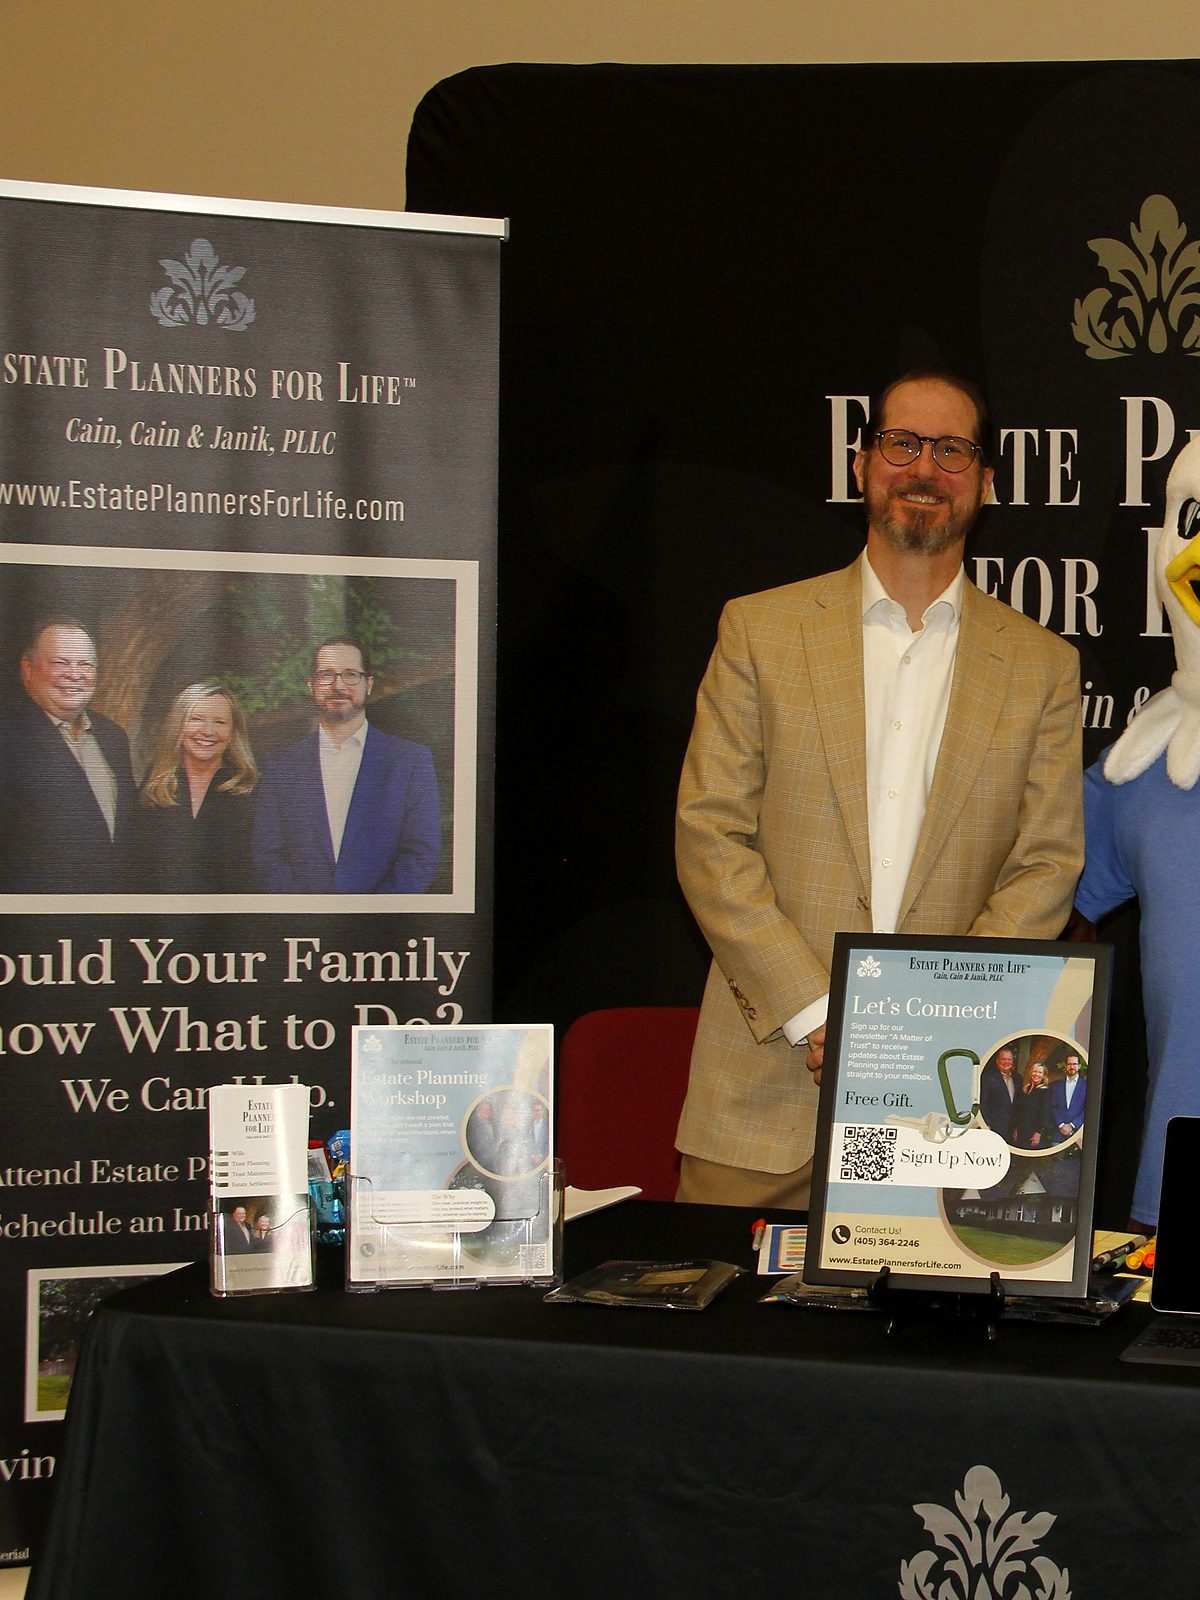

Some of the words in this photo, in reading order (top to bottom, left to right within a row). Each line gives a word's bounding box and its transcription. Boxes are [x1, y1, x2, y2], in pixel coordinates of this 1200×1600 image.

[3, 353, 89, 388] STATE
[103, 347, 256, 398] PLANNERS
[271, 369, 324, 401] FOR
[65, 417, 122, 450] Cain,
[130, 420, 180, 448] Cain
[187, 424, 204, 449] &
[210, 425, 275, 457] Janik,
[282, 429, 337, 455] PLLC
[0, 938, 116, 986] ould
[129, 938, 266, 985] Your
[283, 937, 470, 996] Family
[909, 957, 939, 971] ESTATE
[943, 958, 985, 973] PLANNERS
[988, 963, 1004, 973] FOR
[934, 971, 949, 980] Cain,
[949, 972, 964, 980] Cain
[989, 974, 1004, 982] PLLC
[906, 997, 998, 1020] Connect!
[109, 1006, 267, 1054] What
[285, 1013, 336, 1051] to
[851, 1022, 867, 1031] Sign
[880, 1023, 890, 1031] for
[881, 1043, 909, 1051] receive
[848, 1052, 878, 1060] updates
[847, 1061, 879, 1070] Planning
[880, 1062, 895, 1070] and
[416, 1070, 489, 1088] Planning
[846, 1071, 874, 1080] straight
[60, 1077, 130, 1113] We
[845, 1091, 879, 1106] Free
[882, 1092, 914, 1108] Gift.
[900, 1148, 933, 1167] Sign
[937, 1150, 960, 1168] Up
[963, 1151, 1002, 1168] Now!
[90, 1159, 179, 1184] Estate
[129, 1215, 165, 1233] an
[855, 1225, 887, 1236] Contact
[888, 1227, 902, 1236] Us!
[853, 1236, 876, 1247] (405)
[878, 1237, 920, 1248] 364-2246
[829, 1256, 962, 1270] www.EstatePlannersforLife.com
